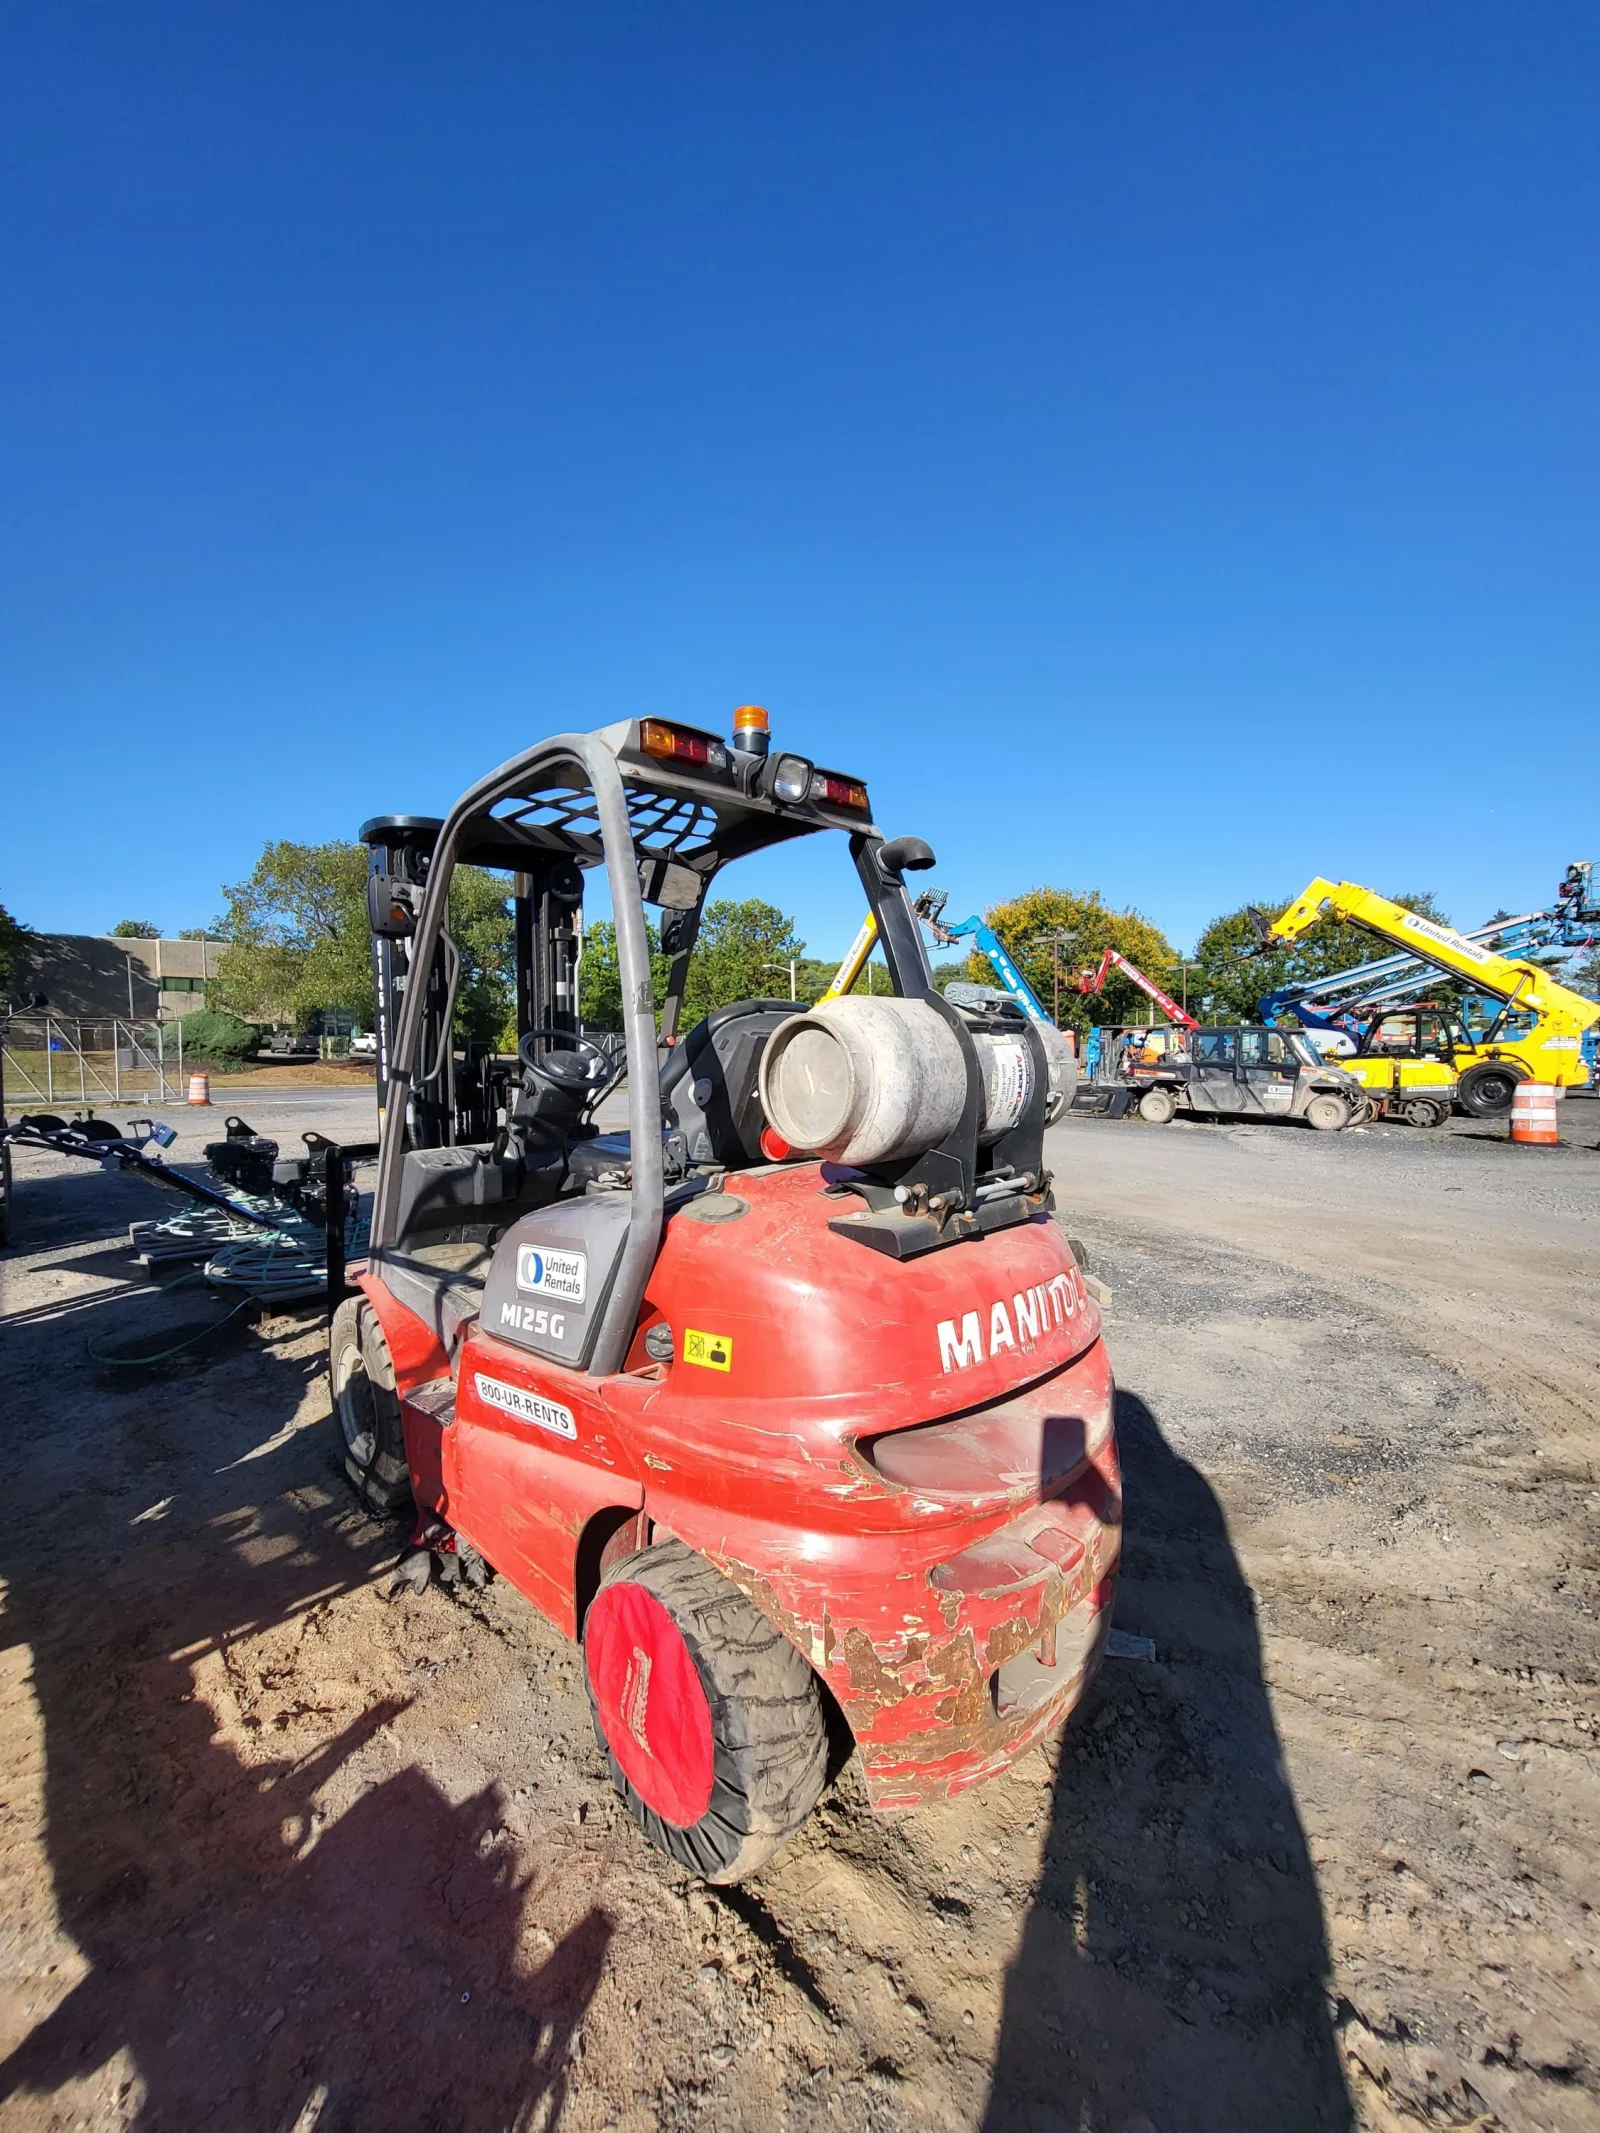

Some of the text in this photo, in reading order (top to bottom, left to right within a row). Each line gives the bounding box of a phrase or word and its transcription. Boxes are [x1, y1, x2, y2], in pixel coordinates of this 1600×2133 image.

[1420, 923, 1485, 960] United Rentals
[1138, 978, 1159, 998] BOOM
[1004, 1077, 1012, 1103] Phone
[545, 1256, 579, 1276] United
[544, 1273, 581, 1295] Rentals
[481, 1381, 569, 1430] 800-UR-RENTS
